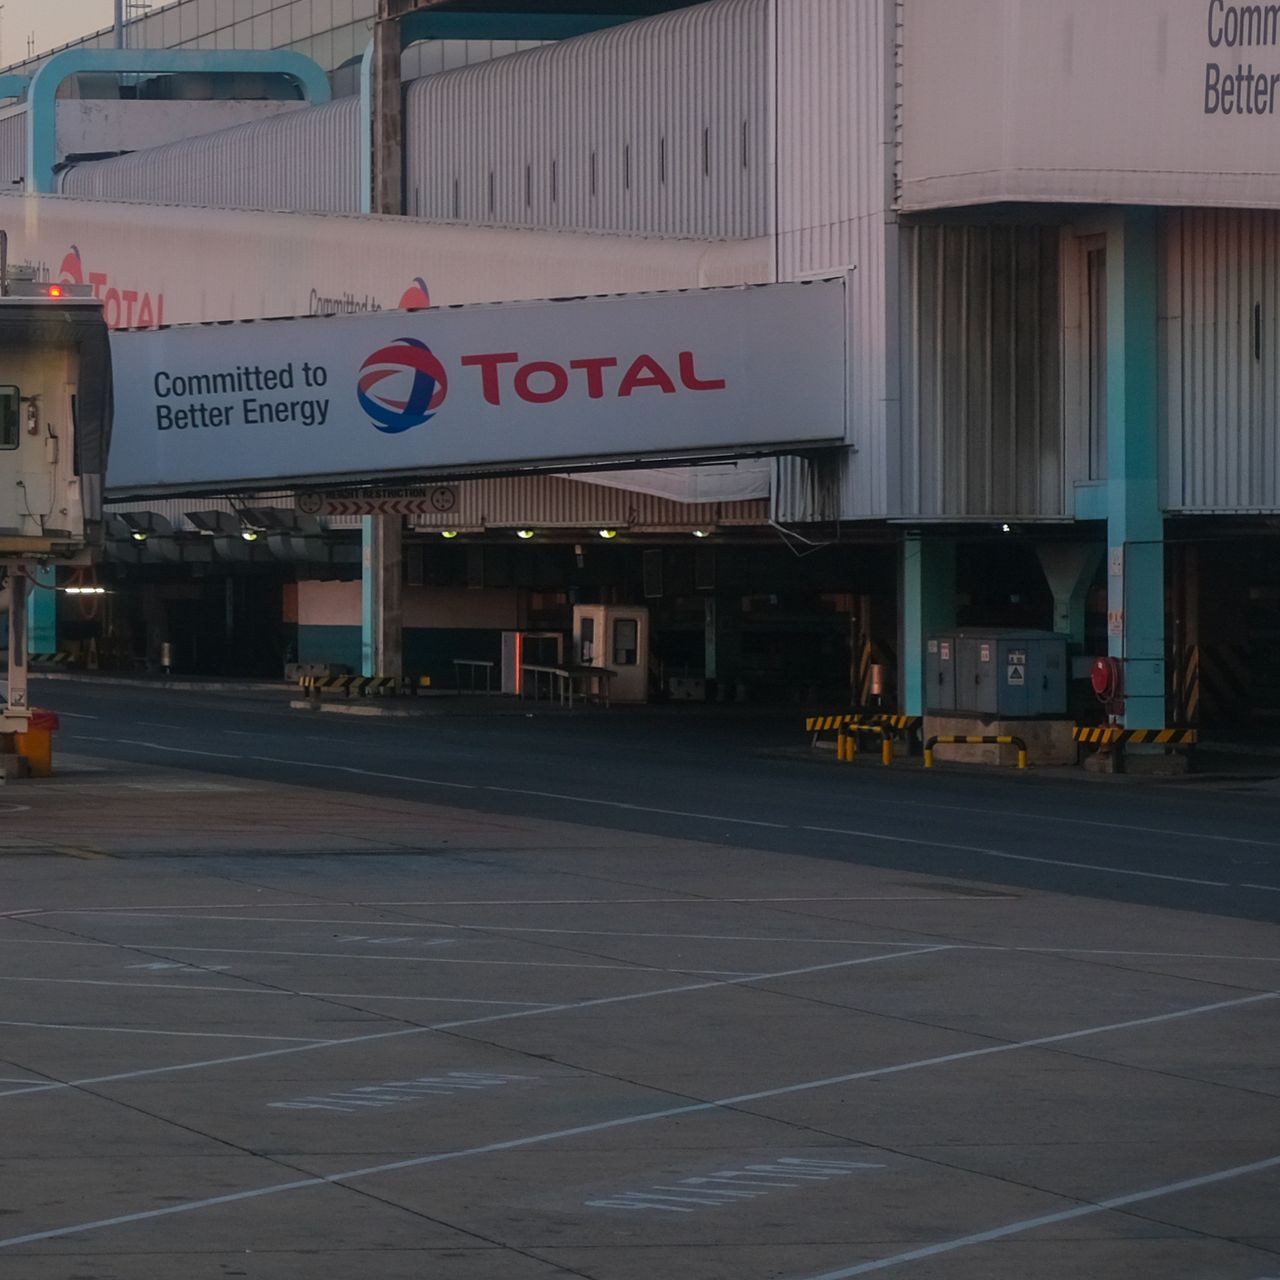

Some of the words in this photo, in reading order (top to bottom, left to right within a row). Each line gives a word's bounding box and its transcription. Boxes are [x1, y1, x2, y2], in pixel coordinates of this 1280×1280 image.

[1204, 62, 1280, 115] Better
[153, 362, 294, 398] Committed
[302, 362, 328, 388] to
[461, 351, 726, 407] TOTAL
[156, 402, 235, 431] Better
[242, 398, 330, 427] Energy
